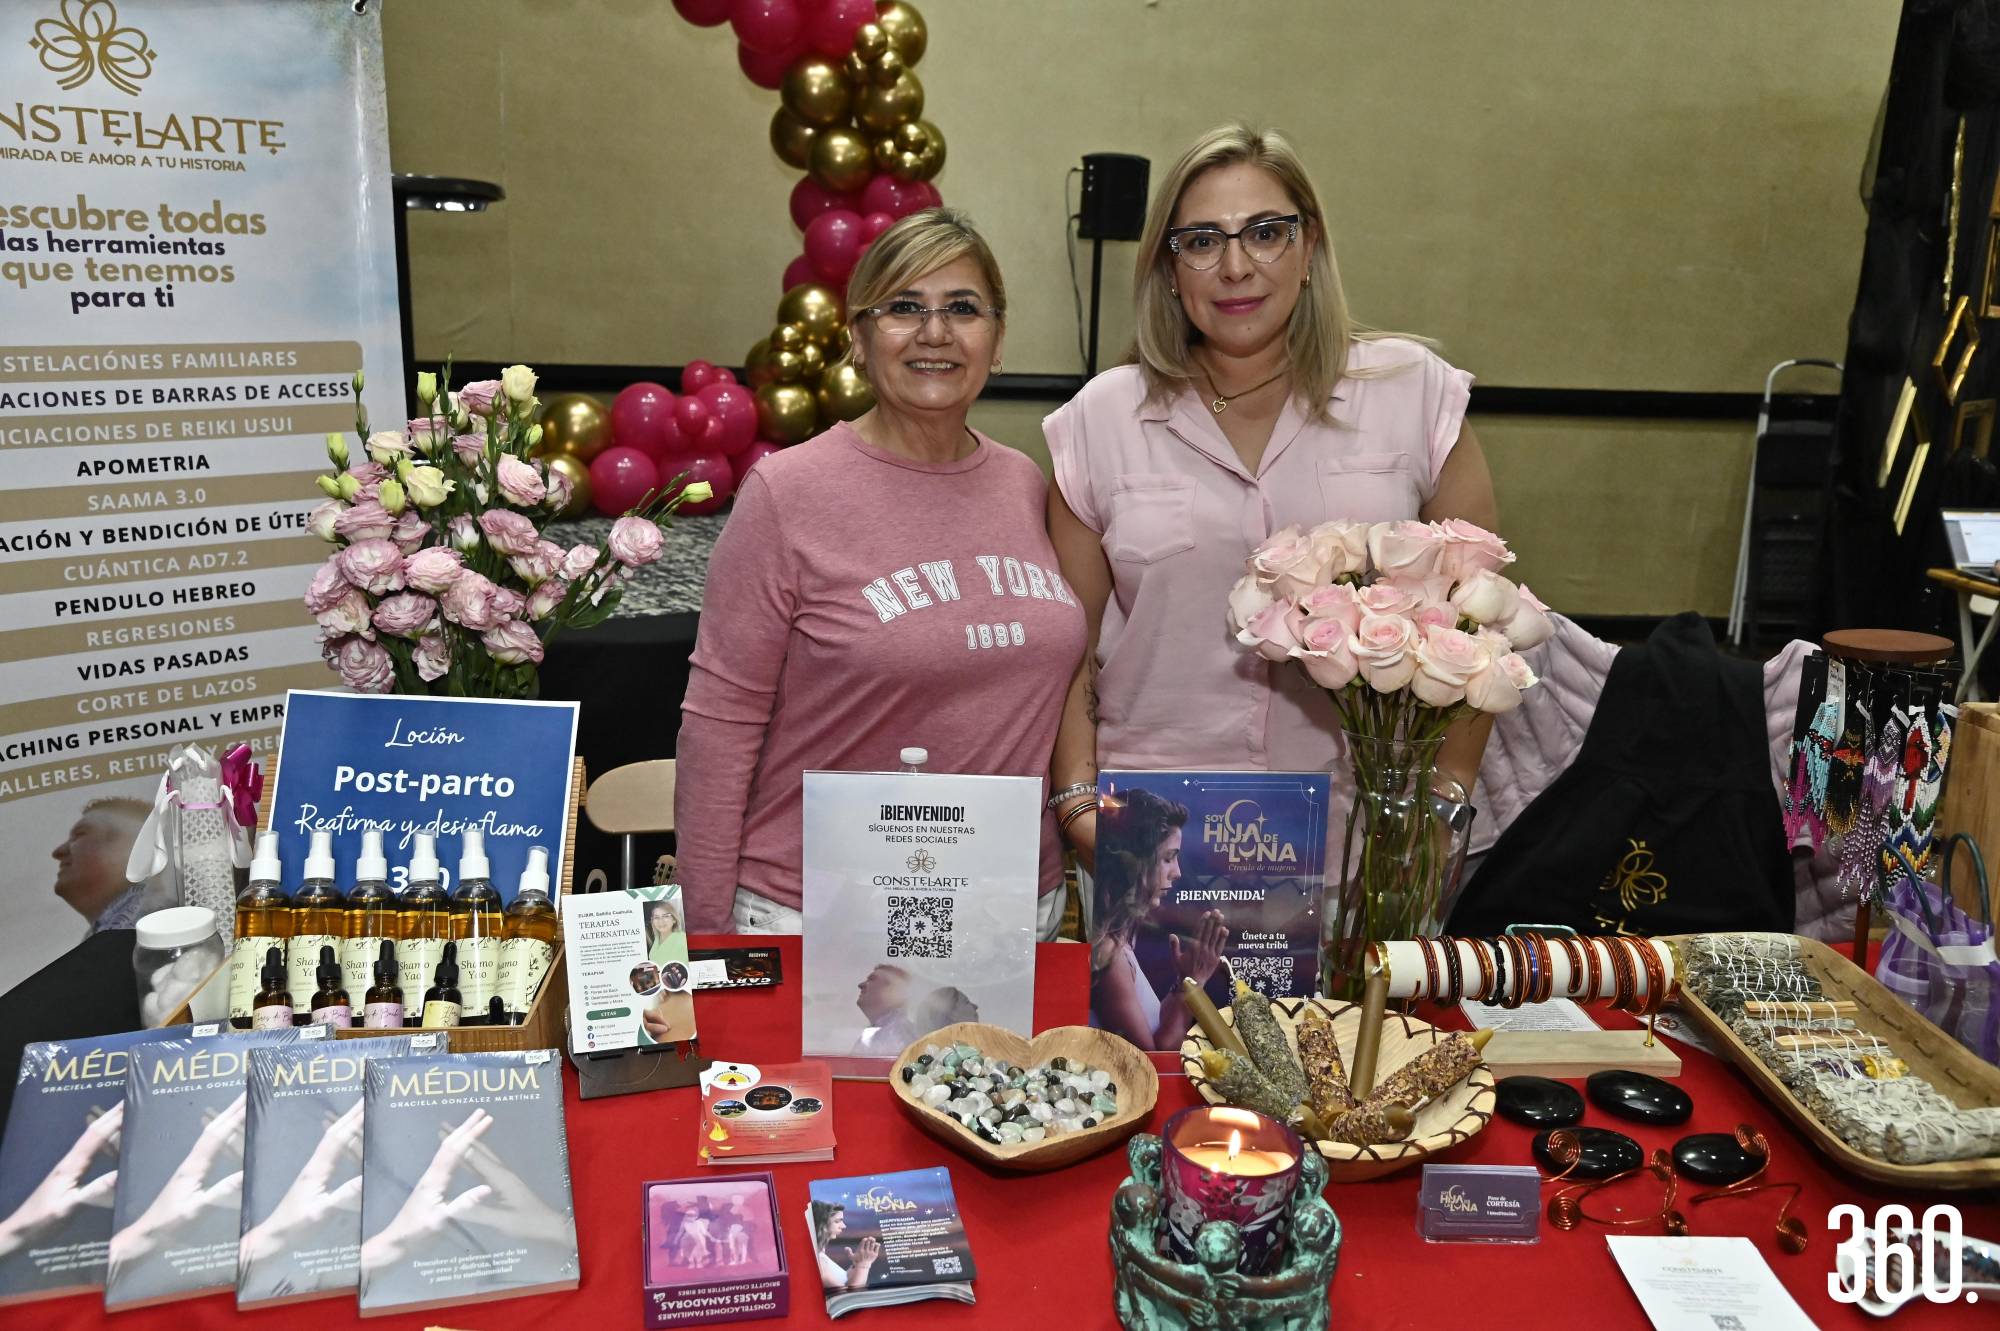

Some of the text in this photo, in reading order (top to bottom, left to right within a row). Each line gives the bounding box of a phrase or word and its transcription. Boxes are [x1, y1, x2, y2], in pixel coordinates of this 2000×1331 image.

[61, 151, 83, 163] DE
[89, 153, 136, 167] AMOR
[141, 156, 152, 167] A
[156, 156, 176, 169] TU
[180, 158, 246, 171] HISTORIA
[158, 200, 266, 235] todas
[0, 229, 225, 256] las herramientas
[2, 258, 235, 289] que tenemos
[71, 284, 174, 314] para ti
[172, 350, 298, 369] FAMILIARES
[0, 381, 349, 409] ACIONES DE BARRAS DE ACCESS
[146, 422, 172, 439] DE
[181, 419, 236, 436] REIKI
[244, 417, 292, 433] USUI
[76, 454, 210, 476] APOMETRIA
[88, 488, 207, 511] SAAMA 3.0
[80, 531, 94, 546] Y
[103, 516, 227, 544] BENDICIÓN
[236, 517, 262, 532] DE
[64, 550, 248, 582] CUÁNTICA AD7.2
[55, 581, 256, 617] PENDULO HEBREO
[862, 556, 1077, 623] NEW YORK
[86, 616, 236, 647] REGRESIONES
[78, 646, 249, 681] VIDAS PASADAS
[77, 676, 257, 714] CORTE DE LAZOS
[89, 715, 203, 746] PERSONAL
[211, 713, 222, 727] Y
[385, 718, 464, 747] Loción
[109, 753, 169, 775] RETIR
[334, 766, 514, 801] Post-parto
[881, 805, 964, 822] ¡BIENVENIDO!
[294, 803, 396, 833] Reafirma
[401, 820, 420, 849] y
[930, 826, 975, 834] NUESTRAS
[1204, 823, 1278, 843] HIJA DE
[915, 836, 957, 844] SOCIALES
[1214, 844, 1228, 852] LA
[391, 866, 450, 893] 30
[873, 876, 968, 887] CONSTELARTE
[1176, 890, 1265, 904] ¡BIENVENIDA!
[579, 919, 620, 928] TERAPIAS
[580, 928, 640, 940] ALTERNATIVAS
[1242, 931, 1266, 940] Únete
[1266, 941, 1288, 950] tribú
[44, 1049, 128, 1082] MÉD
[42, 1084, 91, 1094] GRACIELA
[152, 1085, 202, 1095] GRACIELA
[390, 1066, 540, 1097] MÉDIUM
[274, 1088, 321, 1098] GRACIELA
[390, 1093, 541, 1108] GRACIELA GONZÁLEZ MARTÍNEZ
[661, 1295, 731, 1310] SANADORAS
[734, 1291, 772, 1300] FRASES
[658, 1303, 776, 1320] CONSTELACIONES FAMILIARES
